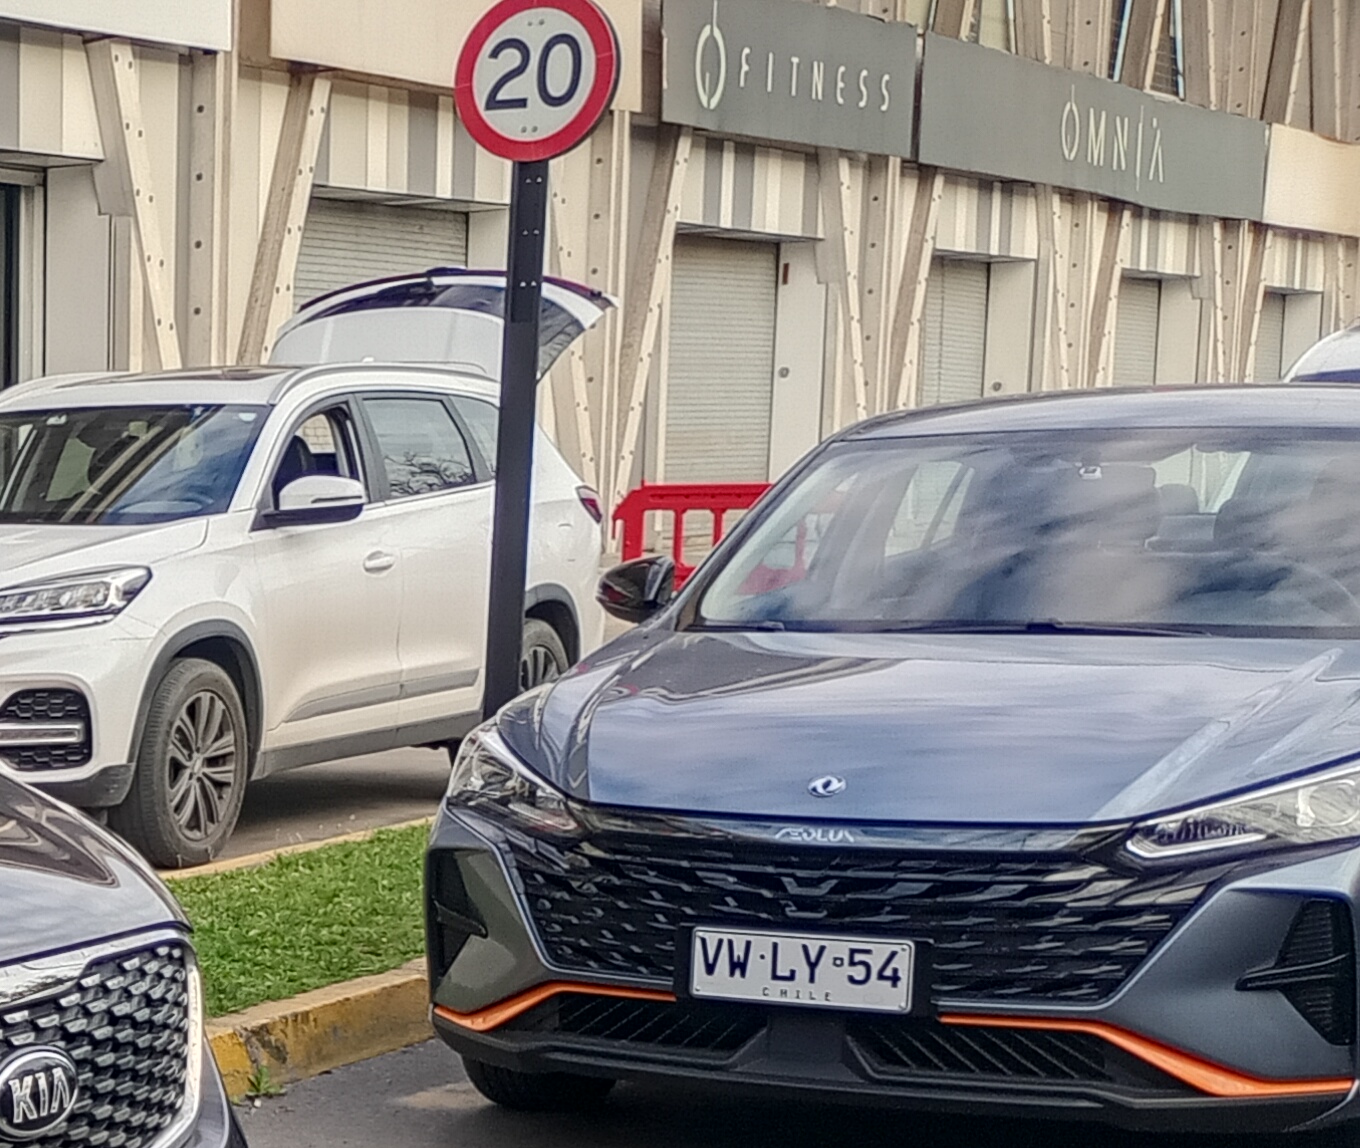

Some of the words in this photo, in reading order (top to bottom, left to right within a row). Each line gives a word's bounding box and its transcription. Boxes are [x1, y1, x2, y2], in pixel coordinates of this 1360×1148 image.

[484, 33, 582, 111] 20
[739, 47, 890, 111] FITNESS
[762, 987, 831, 1001] CHILE
[8, 1067, 70, 1124] KIA
